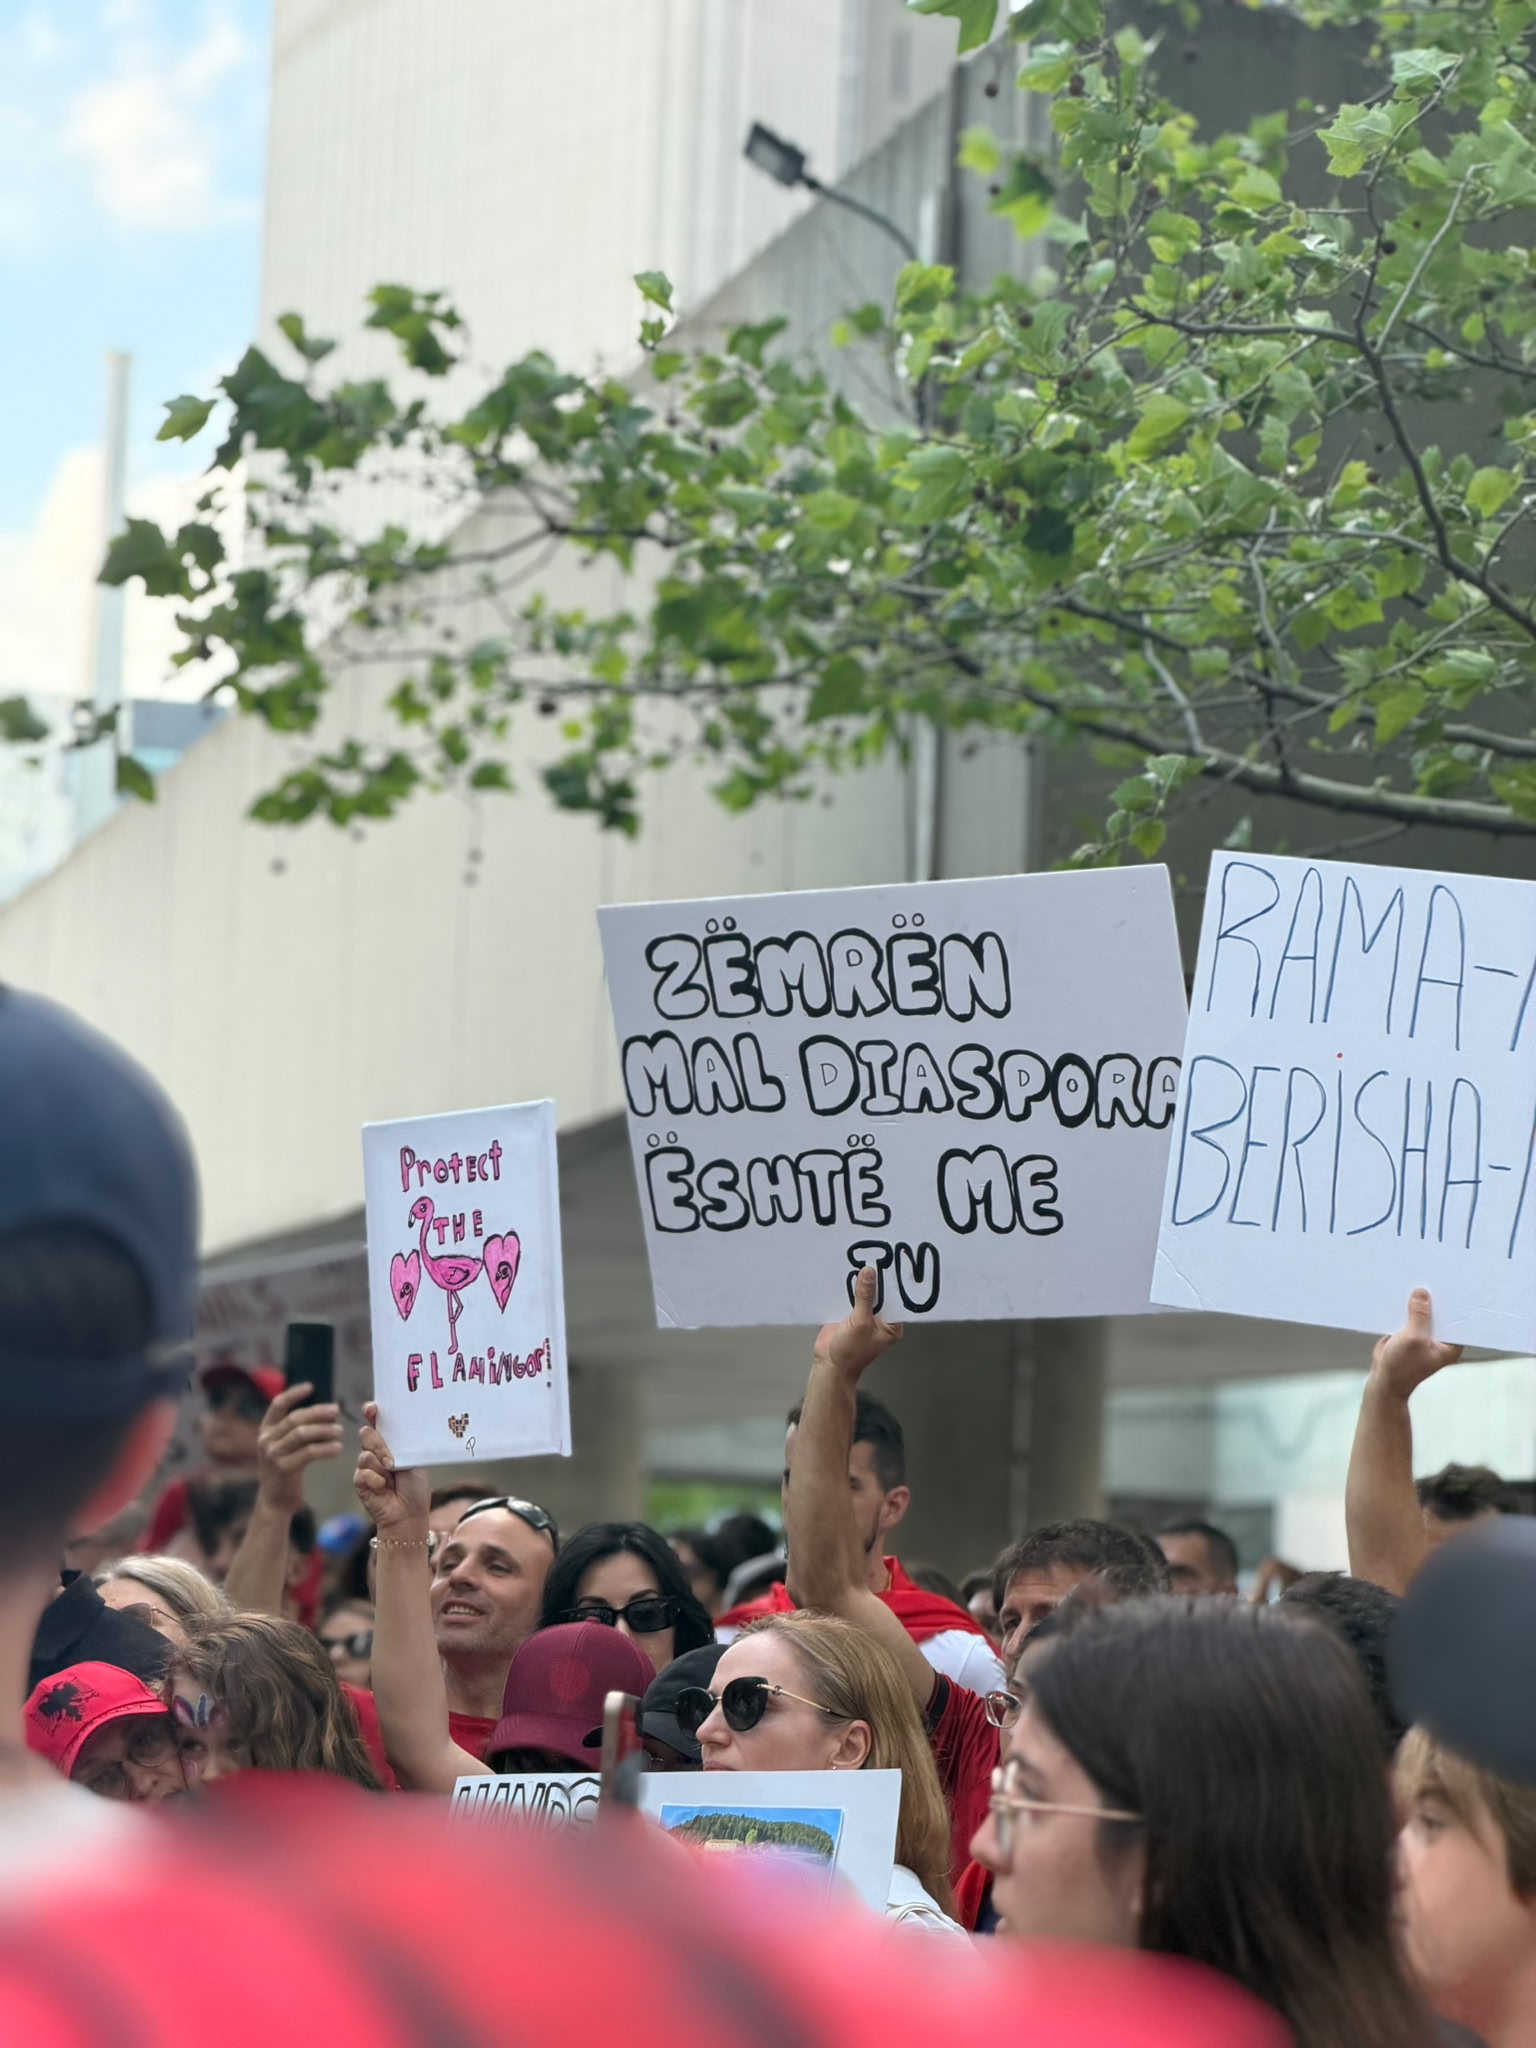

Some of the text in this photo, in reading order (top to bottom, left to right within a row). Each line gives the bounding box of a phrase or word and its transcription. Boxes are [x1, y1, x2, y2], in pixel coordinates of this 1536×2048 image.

[645, 913, 1012, 1022] ZËMRËN
[1207, 861, 1536, 1052] RAMA-
[621, 1030, 1183, 1129] MAL DIASPORA
[645, 1131, 1064, 1235] ËSHTË ME
[1173, 1055, 1536, 1260] BERISHA-
[433, 1208, 483, 1245] THE
